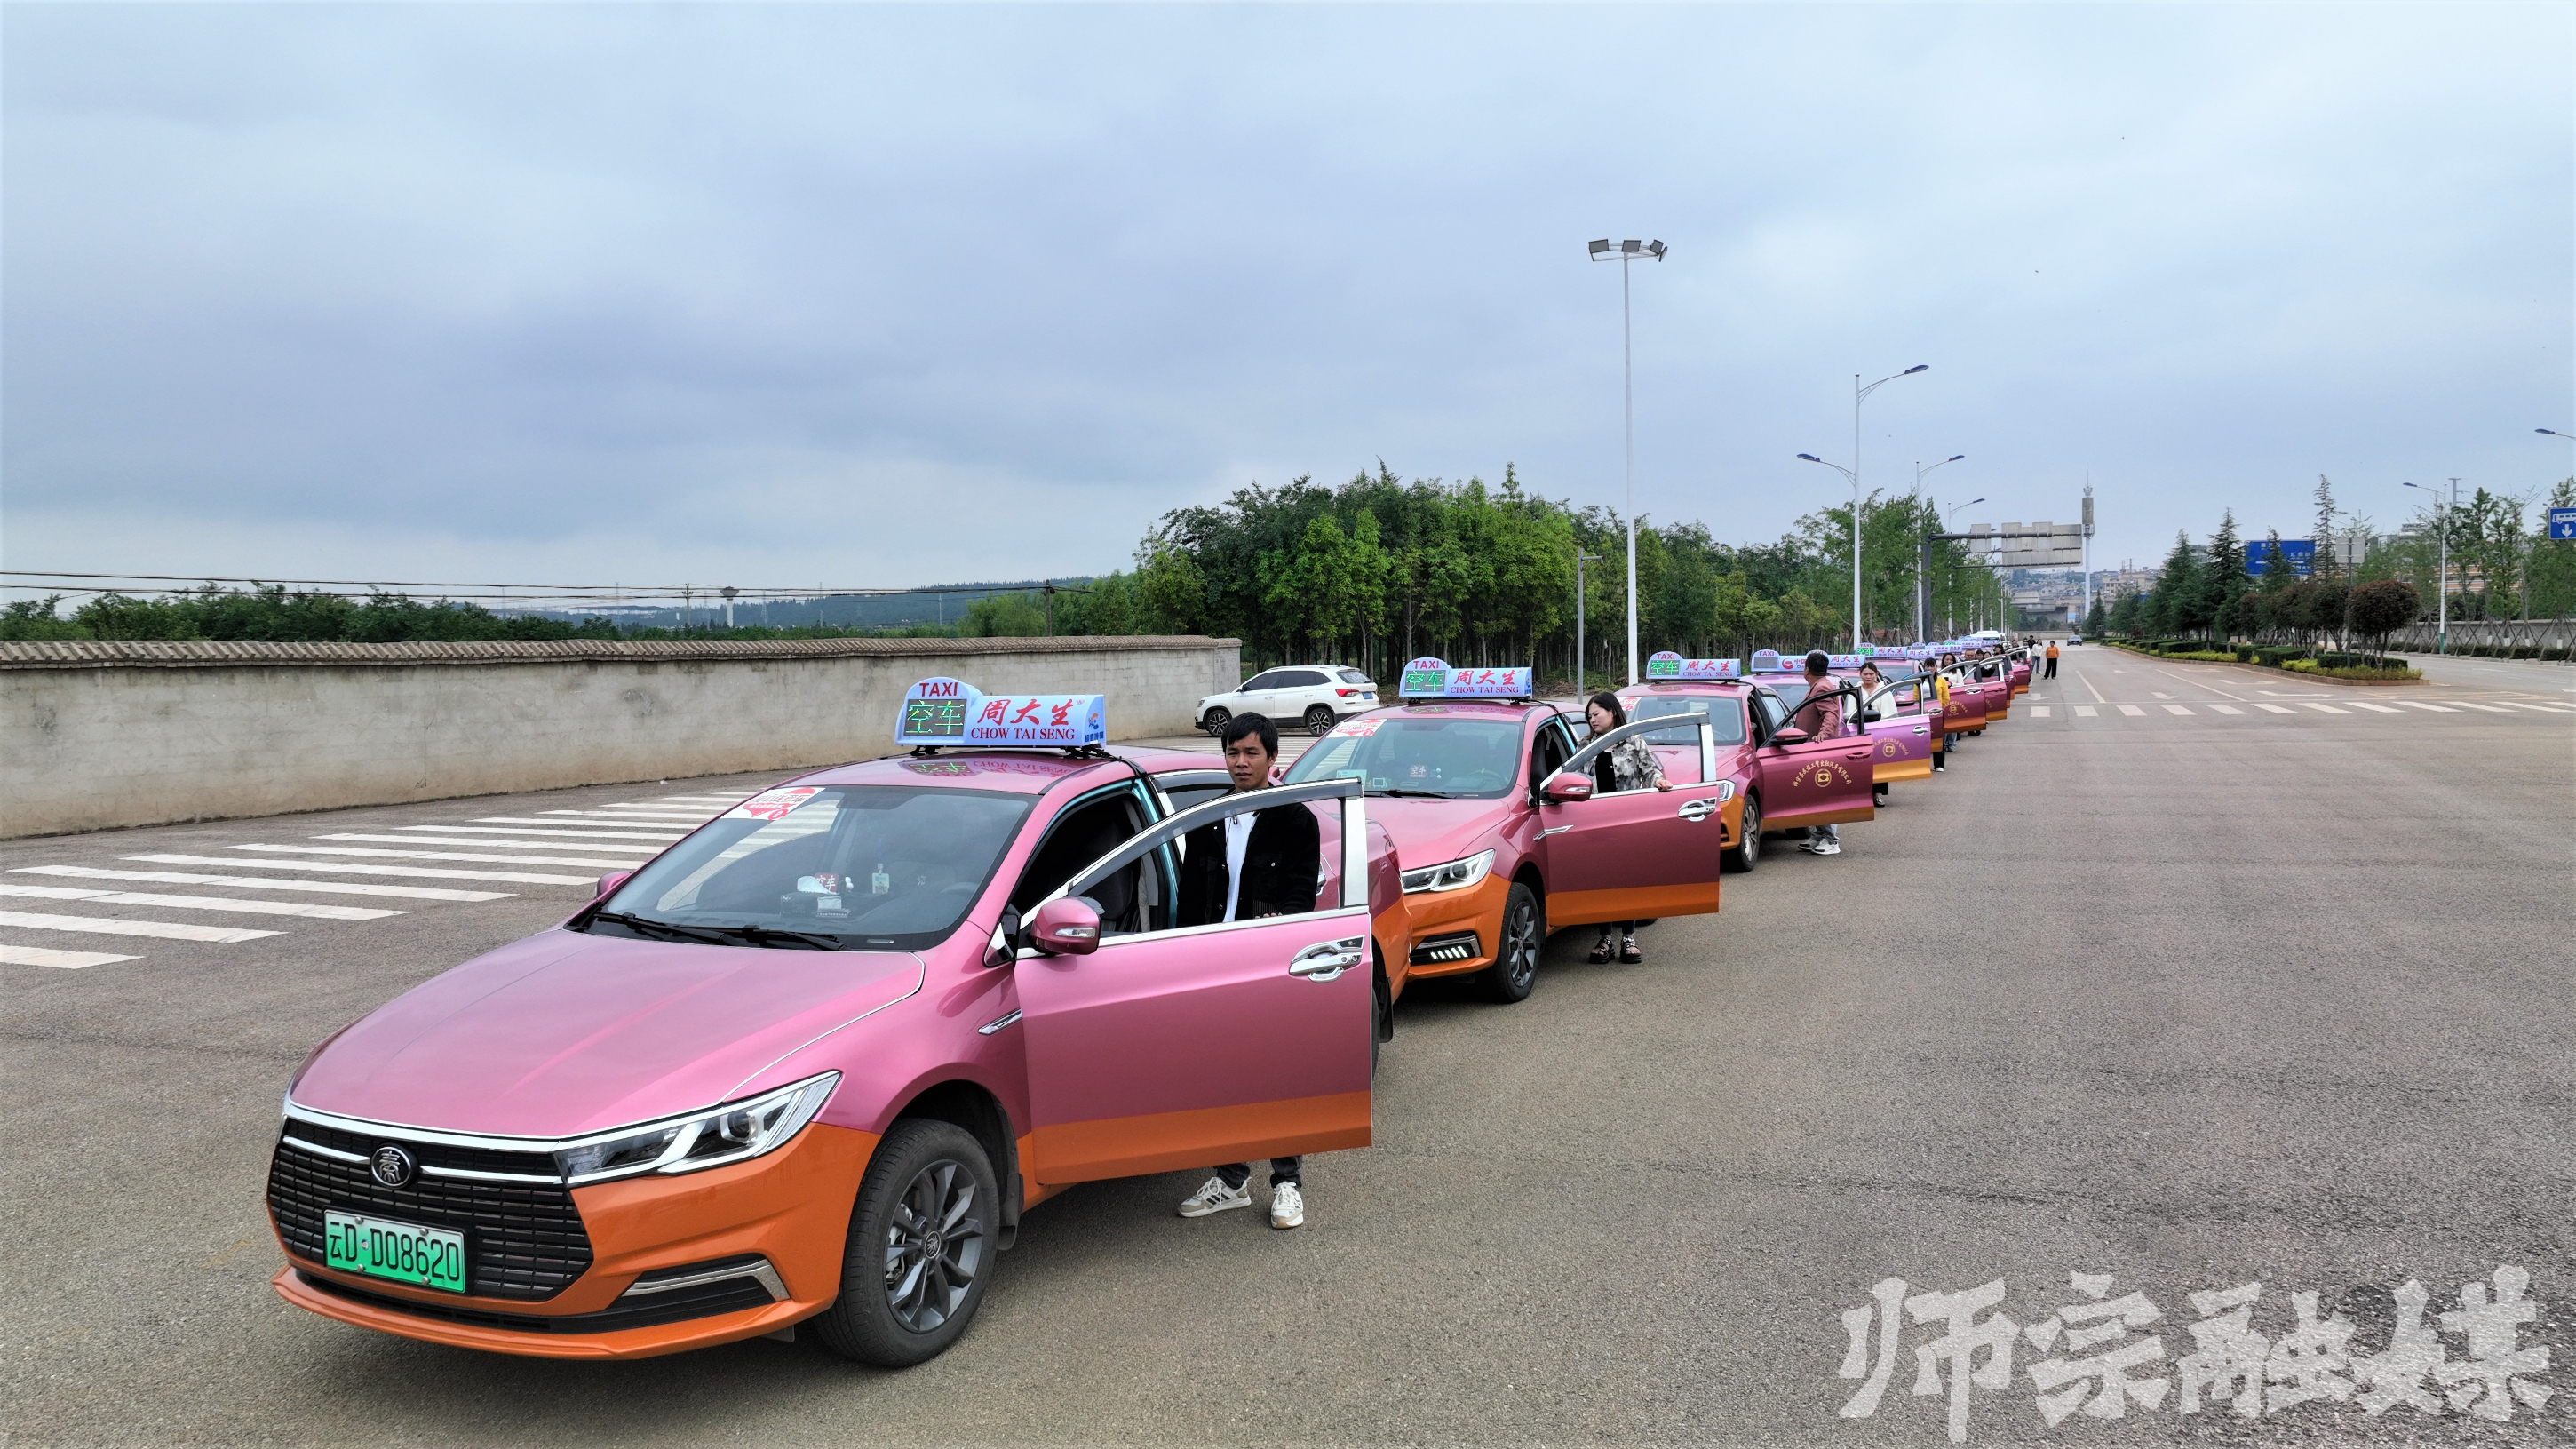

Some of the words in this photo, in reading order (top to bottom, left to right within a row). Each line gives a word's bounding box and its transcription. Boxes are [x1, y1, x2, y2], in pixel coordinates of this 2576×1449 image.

[1650, 660, 1679, 675] 空车
[1686, 661, 1730, 671] 周大生
[1405, 671, 1444, 692] 空车
[1454, 670, 1515, 685] 周大生
[919, 682, 958, 697] TAXI
[906, 699, 964, 734] 空车
[977, 698, 1074, 727] 周大生
[971, 728, 1009, 739] CHOW
[1014, 728, 1036, 739] TAI
[1039, 728, 1075, 739] SENG
